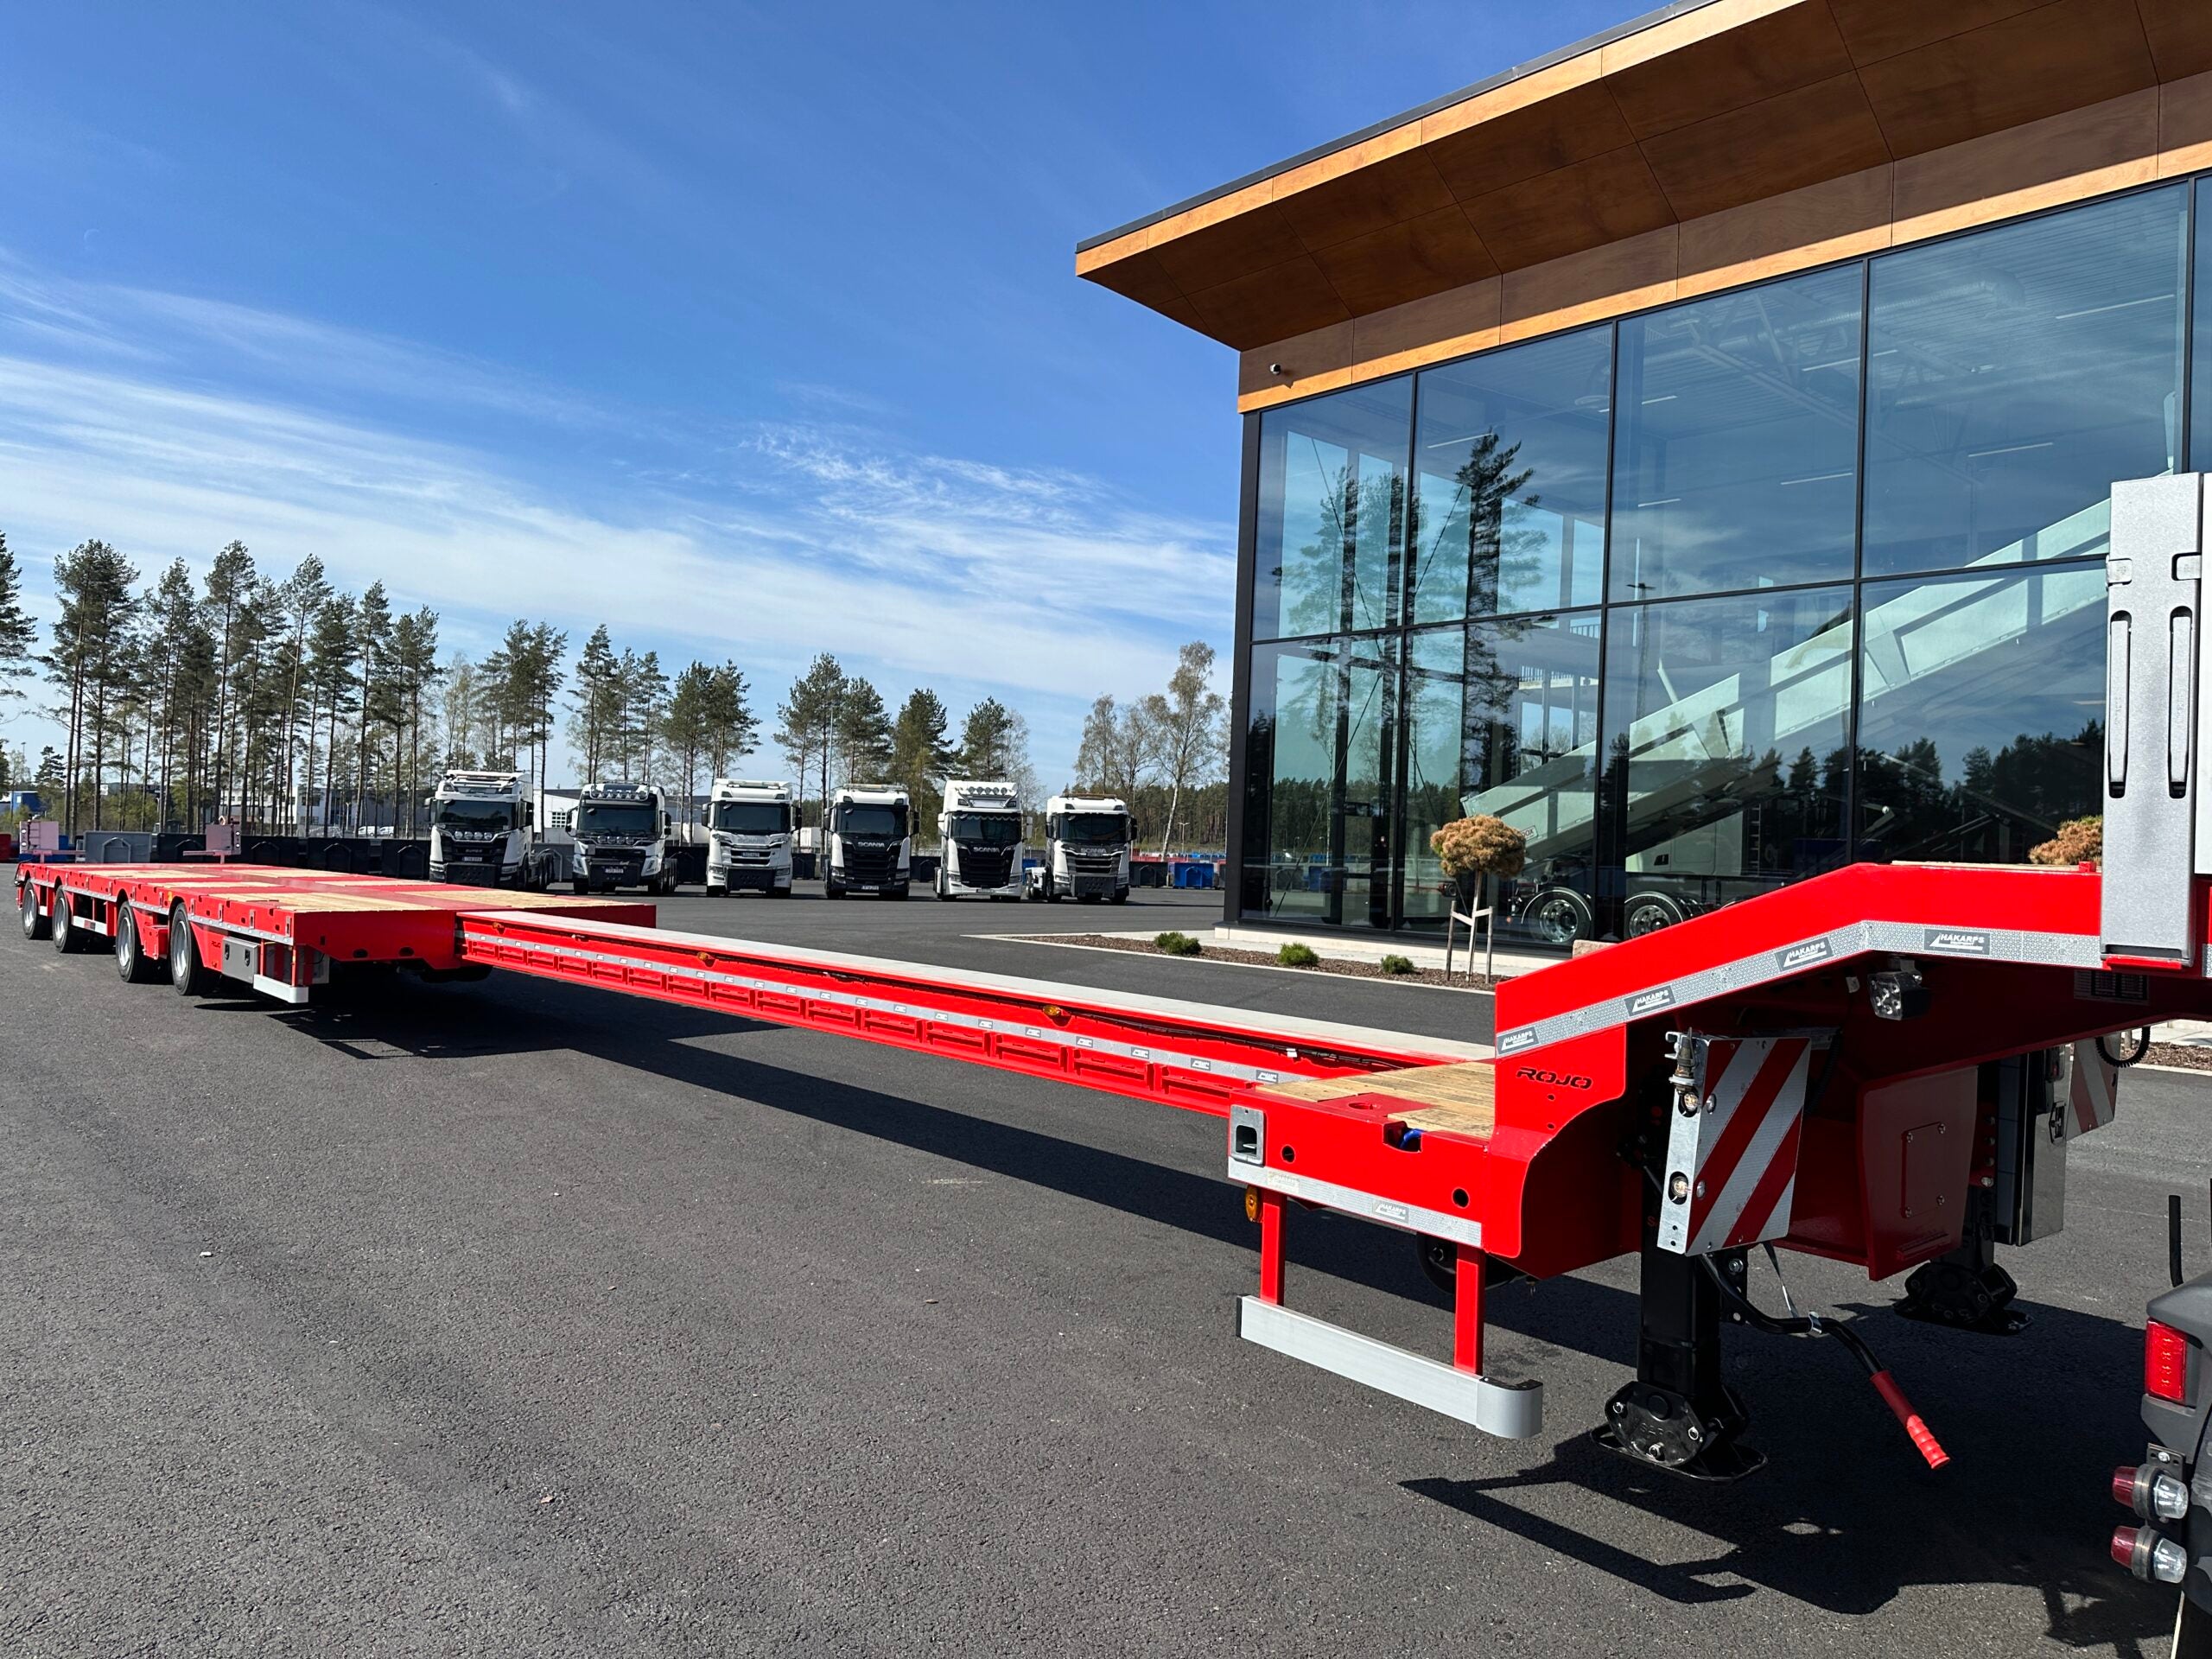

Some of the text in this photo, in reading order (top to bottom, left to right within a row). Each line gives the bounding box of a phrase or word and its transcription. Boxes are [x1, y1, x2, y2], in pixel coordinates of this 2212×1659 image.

[1940, 933, 1985, 944] HAKARPS
[1788, 942, 1826, 958] HAKARPS
[1636, 989, 1669, 1004] HAKARPS
[1505, 1030, 1533, 1043] HAKARPS
[1516, 1066, 1592, 1090] ROJO
